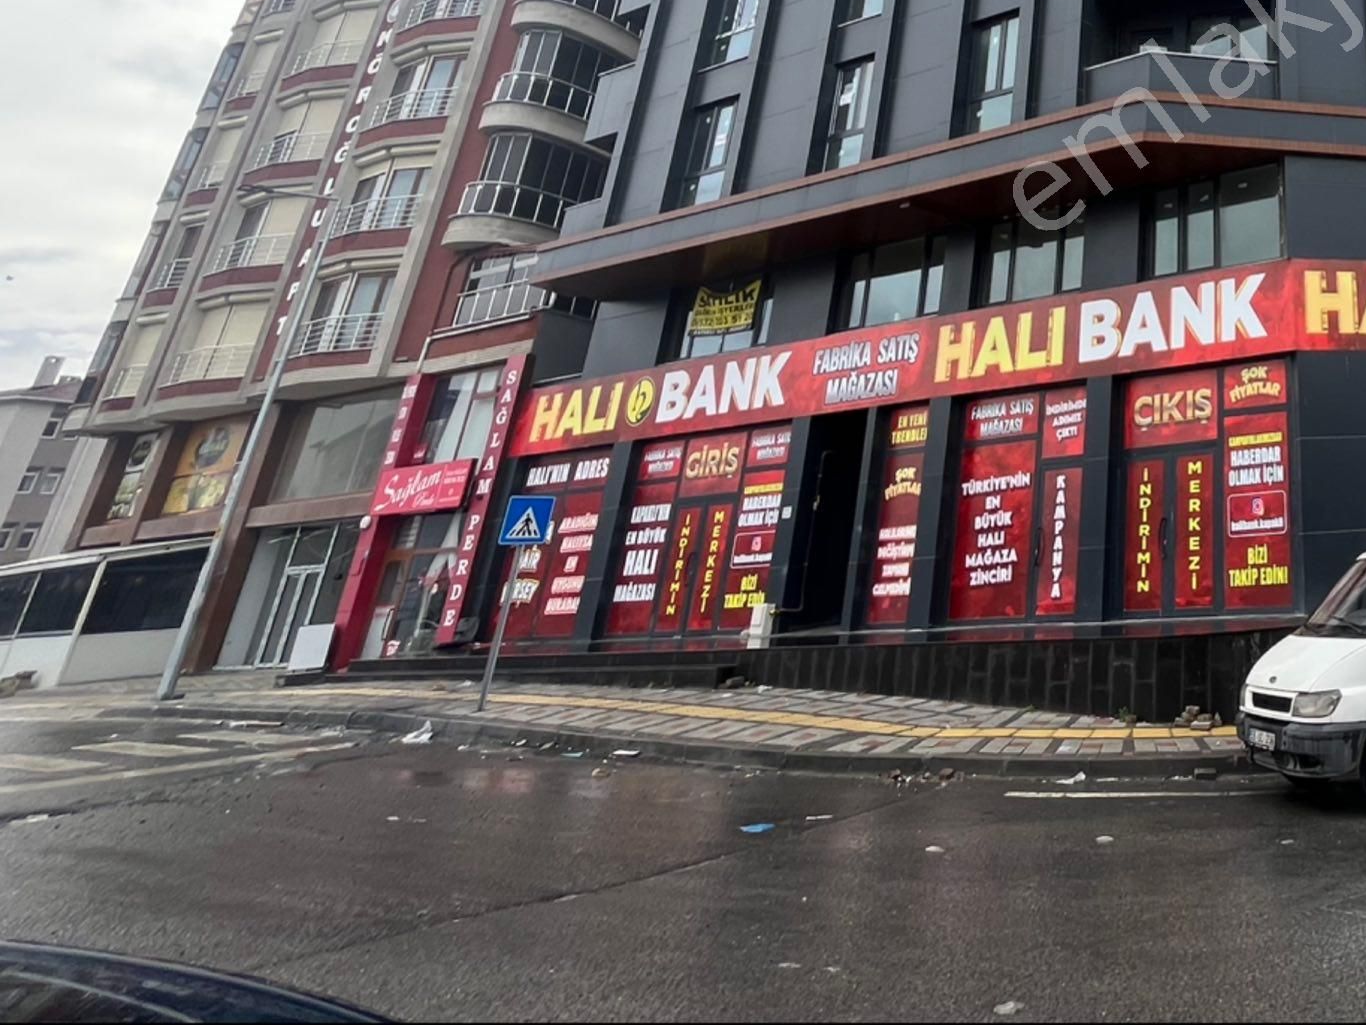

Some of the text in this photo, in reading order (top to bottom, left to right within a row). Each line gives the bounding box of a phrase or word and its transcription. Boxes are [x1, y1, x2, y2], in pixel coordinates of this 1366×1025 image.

[934, 273, 1267, 384] HALI BANK
[813, 333, 919, 375] FABRİKA SATIŞ
[1240, 365, 1268, 384] ŞOK
[529, 381, 624, 444] HALI
[655, 350, 792, 425] BANK
[825, 368, 899, 406] MAĞAZASI
[1229, 381, 1282, 403] FİYATLAR
[1009, 397, 1034, 415] SATIŞ
[1133, 387, 1213, 432] ÇIKIŞ
[476, 370, 517, 495] SAĞLAM
[685, 442, 740, 478] GİRİŞ
[1230, 446, 1282, 467] HABERDAR
[526, 462, 571, 487] HALI'NIN
[961, 470, 1031, 496] TÜRKİYE'NİN
[1228, 463, 1285, 487] OLMAK İÇİN
[985, 495, 1001, 509] EN
[974, 511, 1013, 530] BÜYÜK
[977, 531, 1005, 548] HALI
[1050, 475, 1067, 599] KAMPANYA
[623, 549, 659, 576] HALI
[965, 548, 1018, 568] MAĞAZA
[1247, 543, 1268, 565] BİZİ
[442, 514, 480, 627] PERDE
[970, 564, 1013, 586] ZİNCİRİ
[1228, 566, 1258, 588] TAKİP
[613, 580, 656, 603] MAĞAZASI
